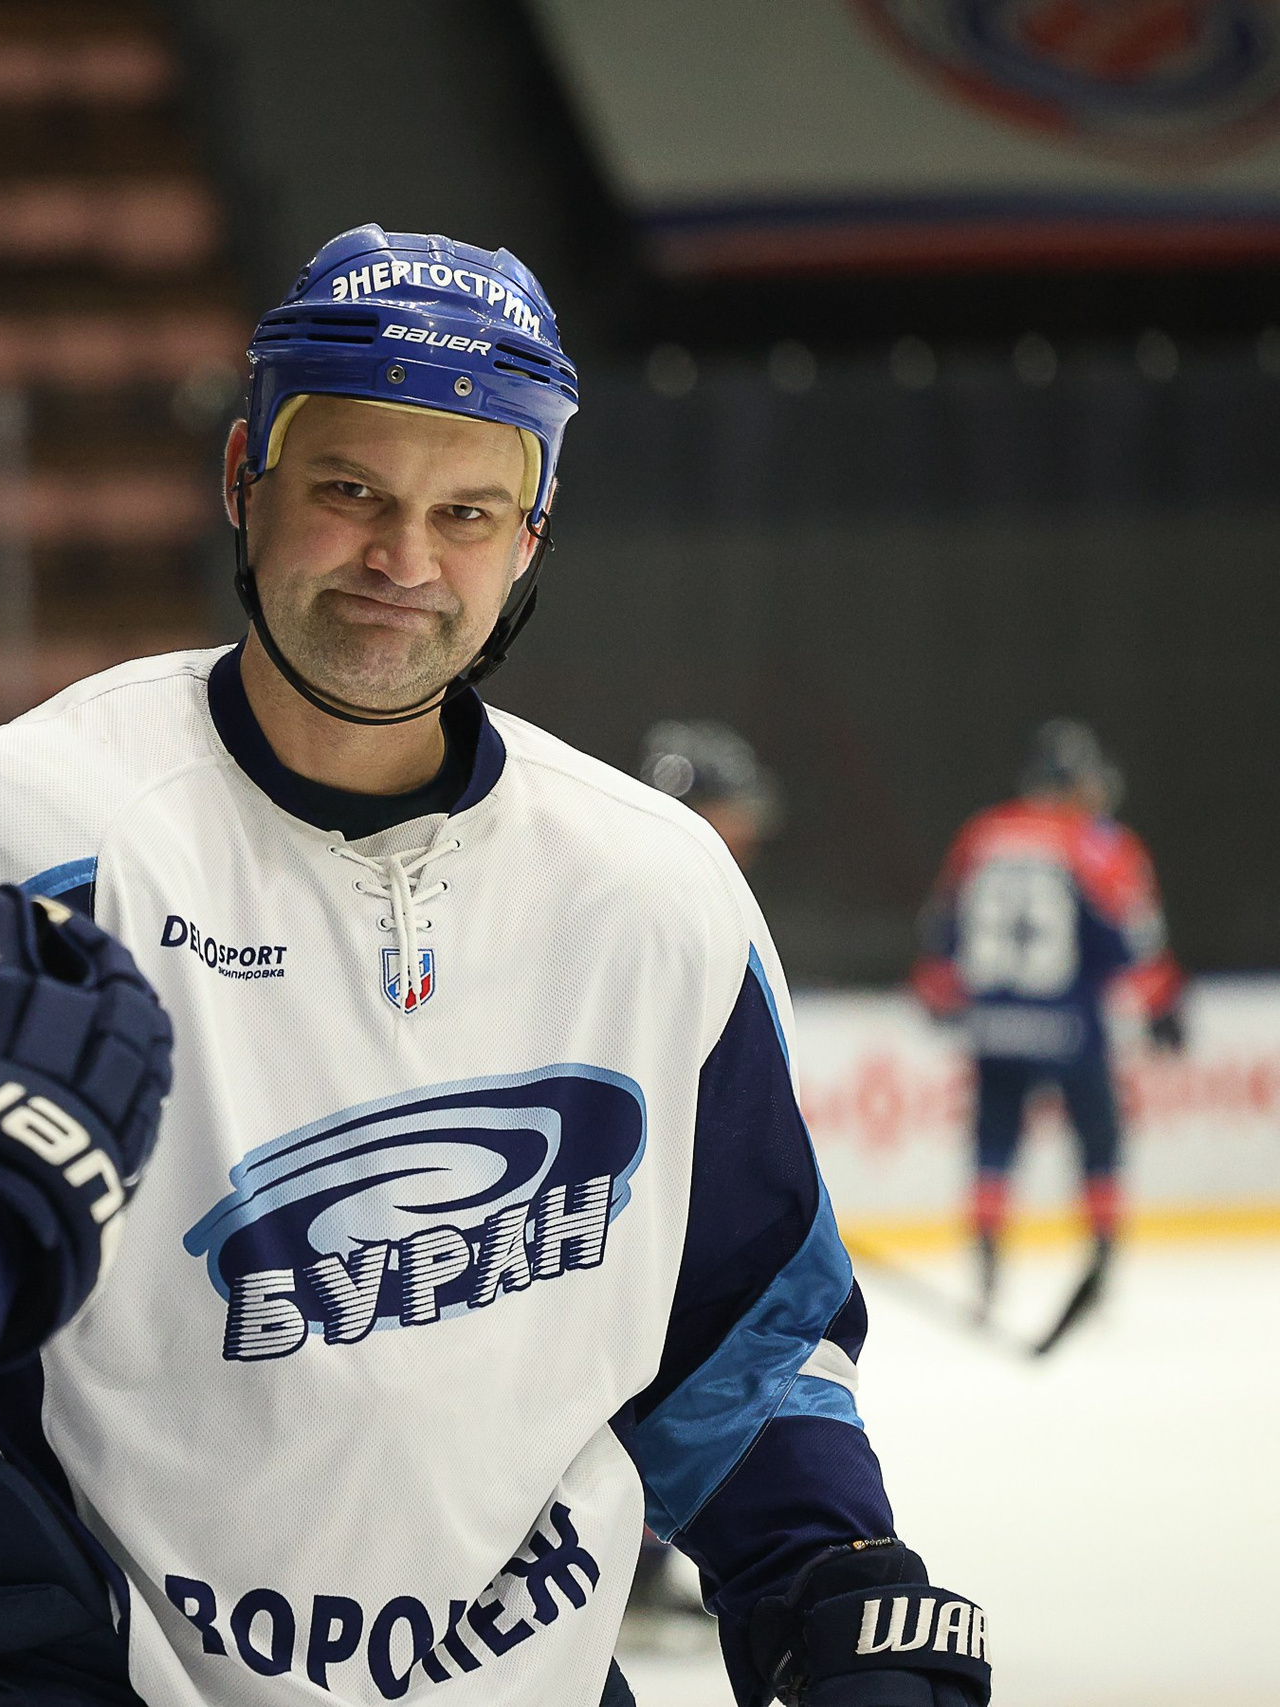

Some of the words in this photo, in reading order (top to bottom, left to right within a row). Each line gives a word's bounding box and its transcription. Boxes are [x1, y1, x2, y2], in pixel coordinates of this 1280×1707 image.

[332, 260, 542, 341] ЭНЕРГОСТРИМ
[382, 323, 492, 356] BAUER
[222, 1173, 613, 1361] БУРАН
[854, 1596, 992, 1665] WAR
